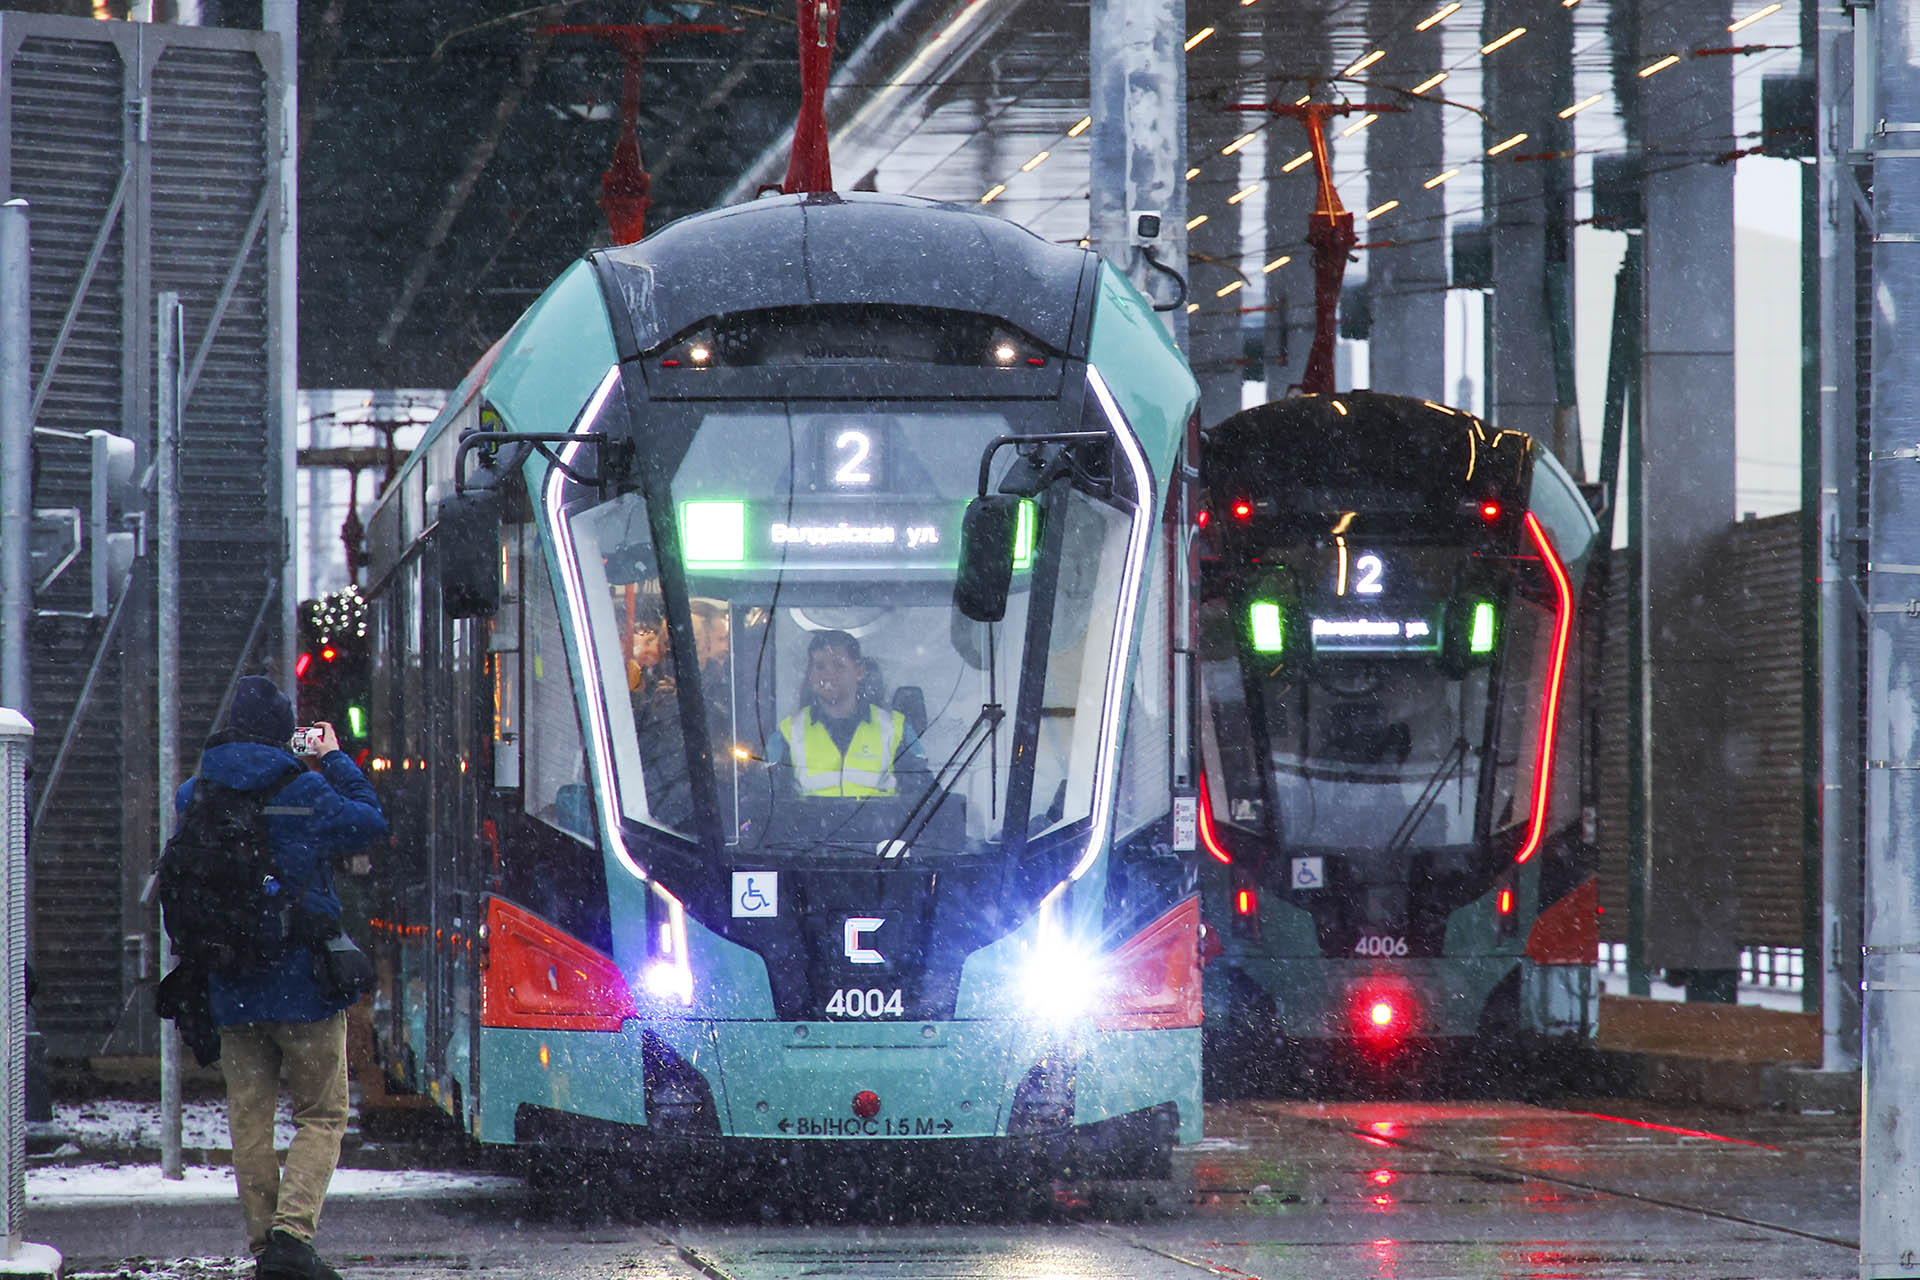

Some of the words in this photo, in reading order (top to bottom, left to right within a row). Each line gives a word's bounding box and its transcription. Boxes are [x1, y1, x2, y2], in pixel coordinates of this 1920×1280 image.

[834, 430, 871, 482] 2
[1356, 555, 1383, 593] 2
[1355, 935, 1409, 956] 4006
[825, 988, 904, 1017] 4004
[797, 1117, 879, 1136] ВЫНОС
